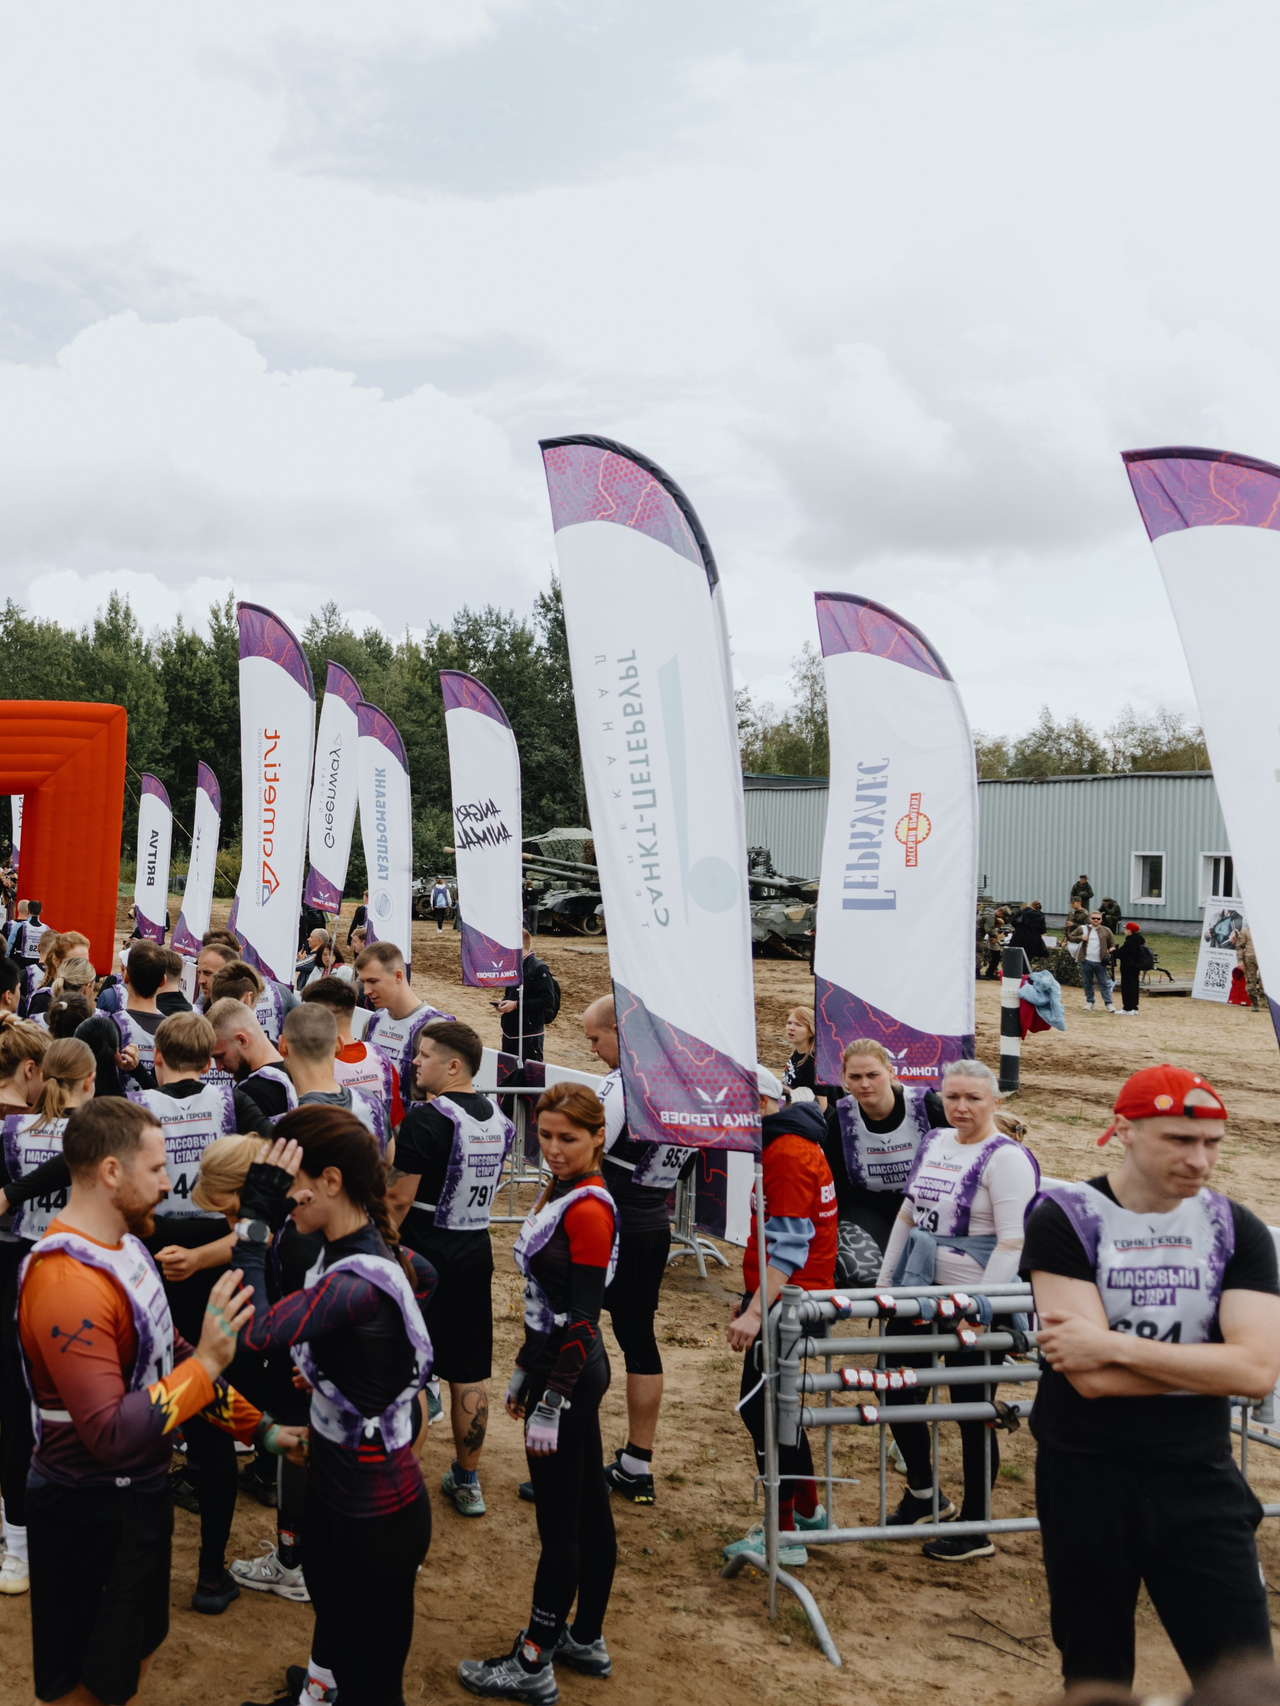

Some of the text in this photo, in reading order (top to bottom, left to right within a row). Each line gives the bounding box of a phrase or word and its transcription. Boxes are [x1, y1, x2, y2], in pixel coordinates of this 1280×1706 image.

[160, 1111, 213, 1123] ГОНКА ГЕРОЕВ
[887, 1142, 913, 1152] ГЕРОЕВ
[477, 1166, 494, 1176] СТАРТ
[883, 1172, 908, 1184] СТАРТ
[467, 1185, 494, 1208] 791
[1113, 1239, 1147, 1249] ГОНК
